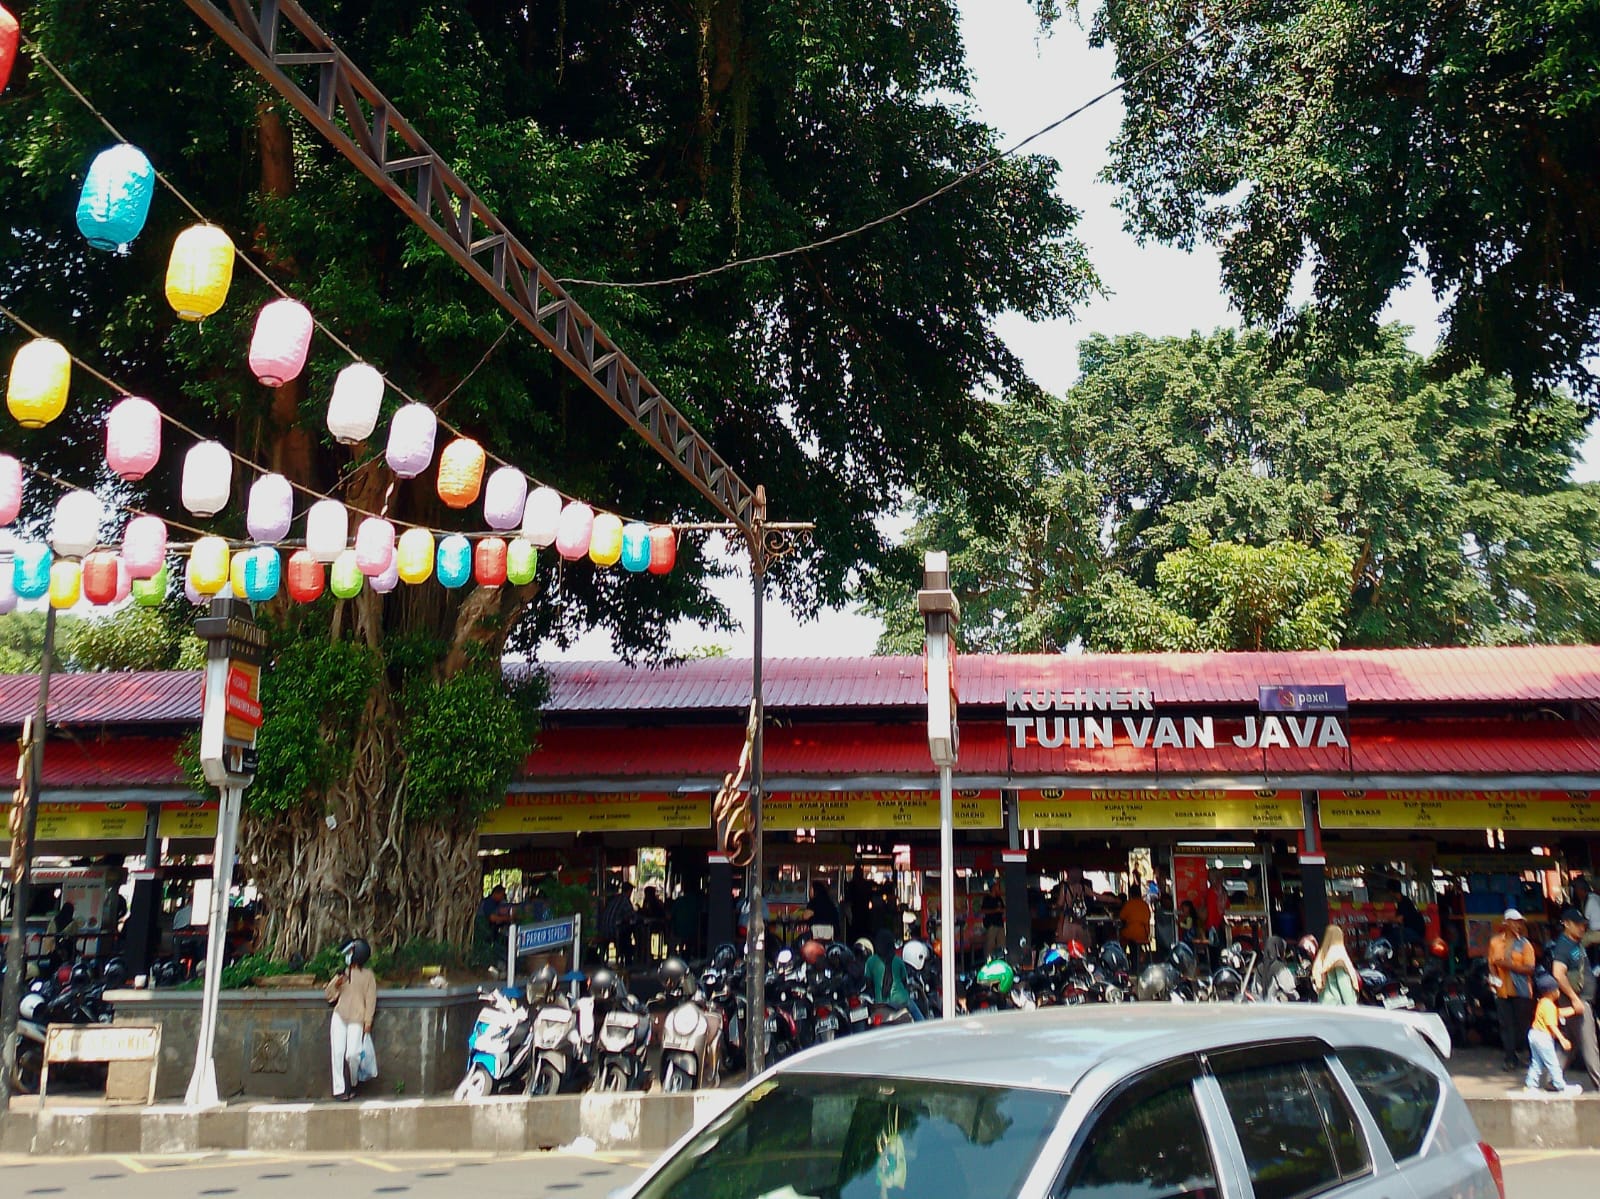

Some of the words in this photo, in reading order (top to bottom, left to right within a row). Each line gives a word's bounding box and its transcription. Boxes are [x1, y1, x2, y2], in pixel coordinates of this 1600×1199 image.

[1006, 687, 1153, 711] KULINER
[1298, 691, 1328, 706] paxel
[1007, 717, 1113, 748] TUIN
[1122, 716, 1215, 748] VAN
[1232, 716, 1349, 748] JAVA
[881, 790, 933, 800] GOLD
[1091, 788, 1171, 800] MUSTIKA
[1176, 788, 1226, 800] GOLD
[526, 930, 546, 946] PARKIR
